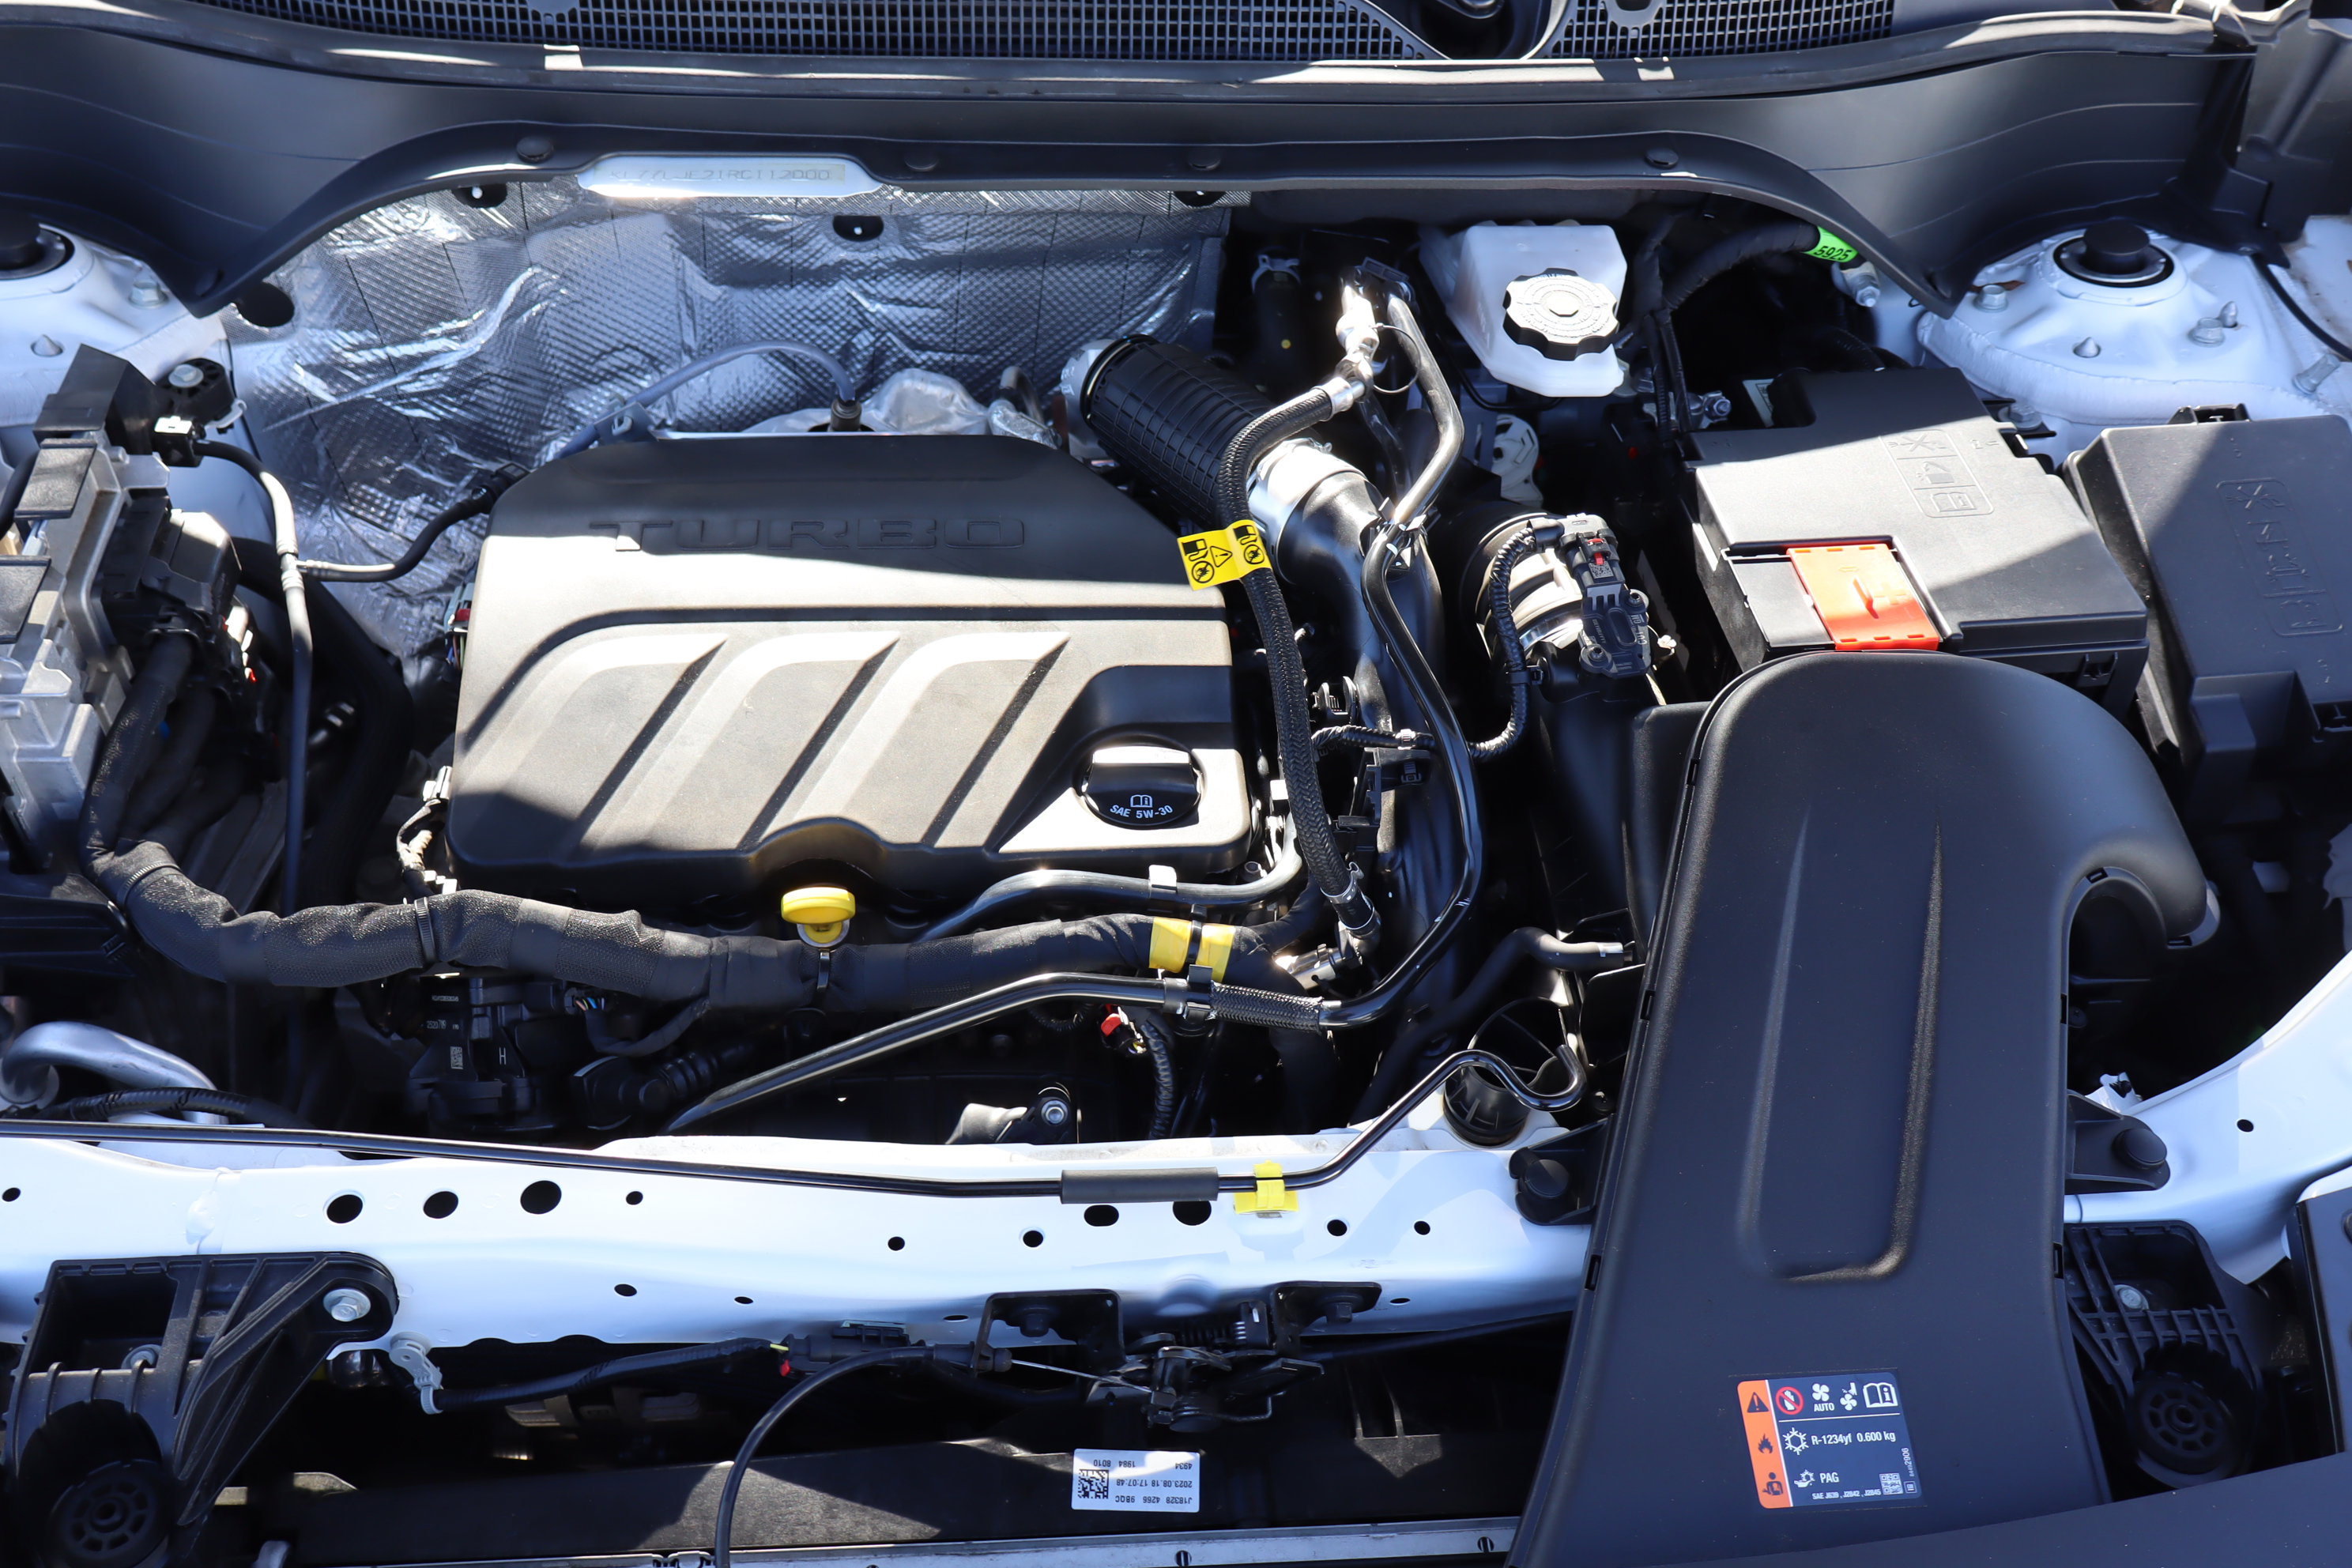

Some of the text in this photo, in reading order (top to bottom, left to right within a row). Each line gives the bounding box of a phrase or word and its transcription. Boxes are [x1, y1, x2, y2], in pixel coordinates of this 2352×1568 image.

[1814, 245, 1853, 261] 5925
[590, 519, 1024, 552] TURBO
[1110, 805, 1173, 819] SAE 5W-30
[499, 1047, 507, 1065] H
[1813, 1402, 1834, 1412] AUTO
[1811, 1430, 1896, 1446] R-1234yf 0.600 kg
[1116, 1479, 1193, 1488] 2023.08.18 17:07:48
[1819, 1472, 1840, 1483] PAG
